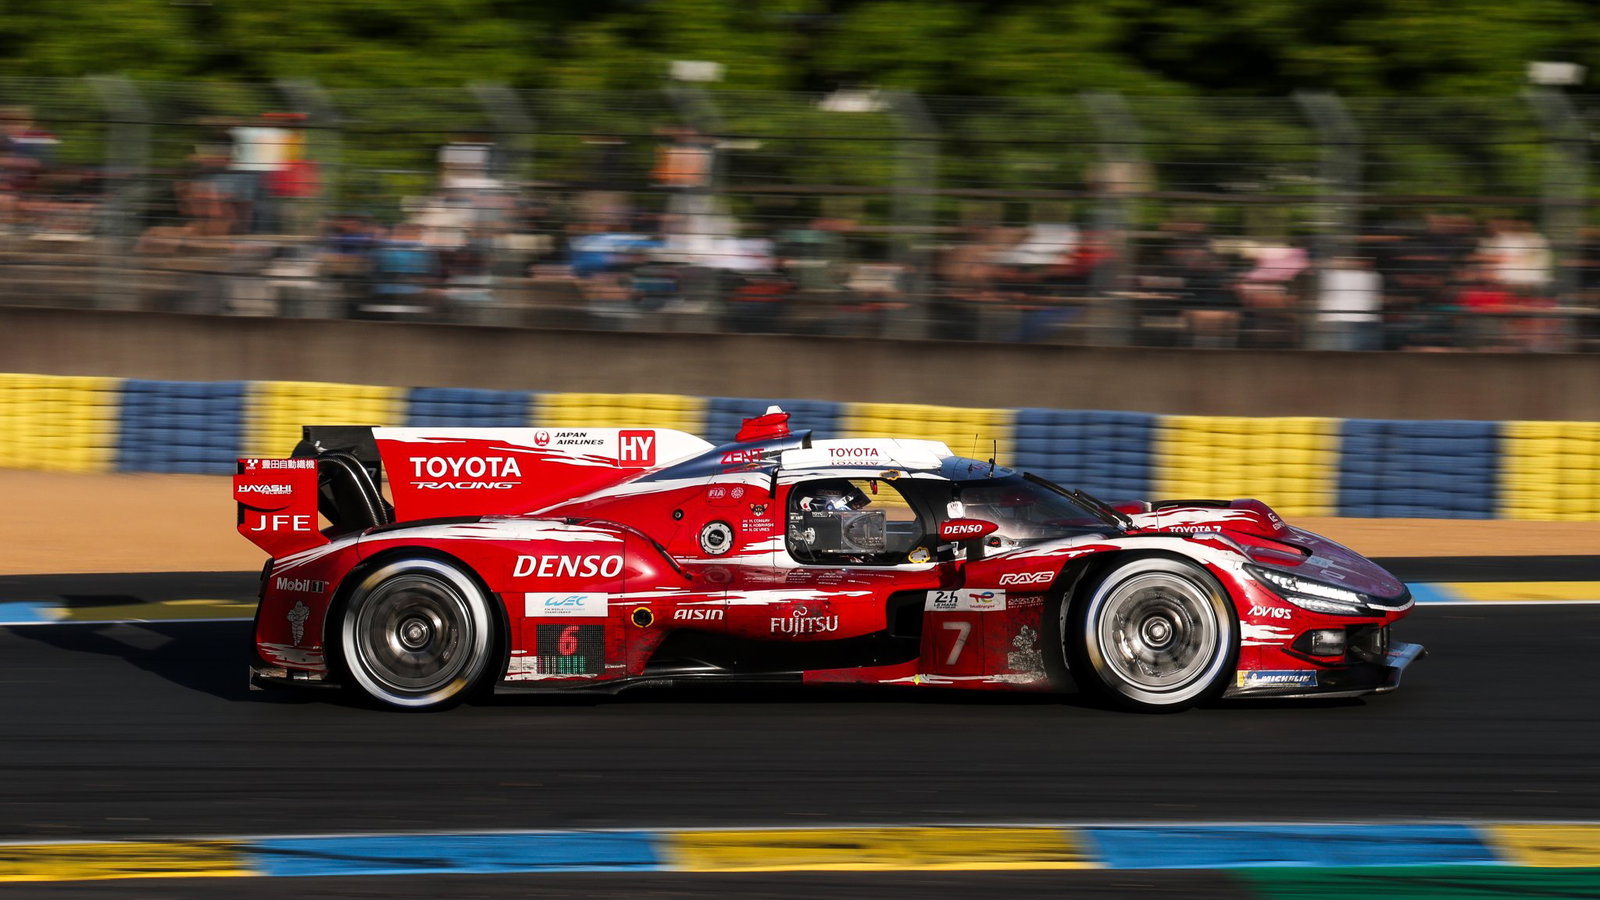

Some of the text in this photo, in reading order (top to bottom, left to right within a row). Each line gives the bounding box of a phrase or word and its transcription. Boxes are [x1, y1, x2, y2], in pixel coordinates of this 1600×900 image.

[620, 436, 653, 461] HY
[828, 447, 879, 458] TOYOTA
[720, 448, 764, 465] ZENT
[409, 456, 522, 478] TOYOTA
[237, 484, 293, 493] HAYASHI
[409, 481, 522, 490] RACING
[708, 489, 724, 497] FIA
[250, 515, 311, 532] JFE
[943, 524, 983, 535] DENSO
[1168, 525, 1211, 533] TOYOTA
[512, 554, 624, 578] DENSO
[276, 577, 310, 592] Mobil
[999, 571, 1055, 585] RAYS
[544, 596, 588, 606] WEC
[673, 608, 724, 620] AISIN
[770, 607, 839, 637] FUJITSU
[557, 625, 580, 656] 6
[942, 621, 972, 665] 7
[1261, 674, 1311, 683] MICHELIN
